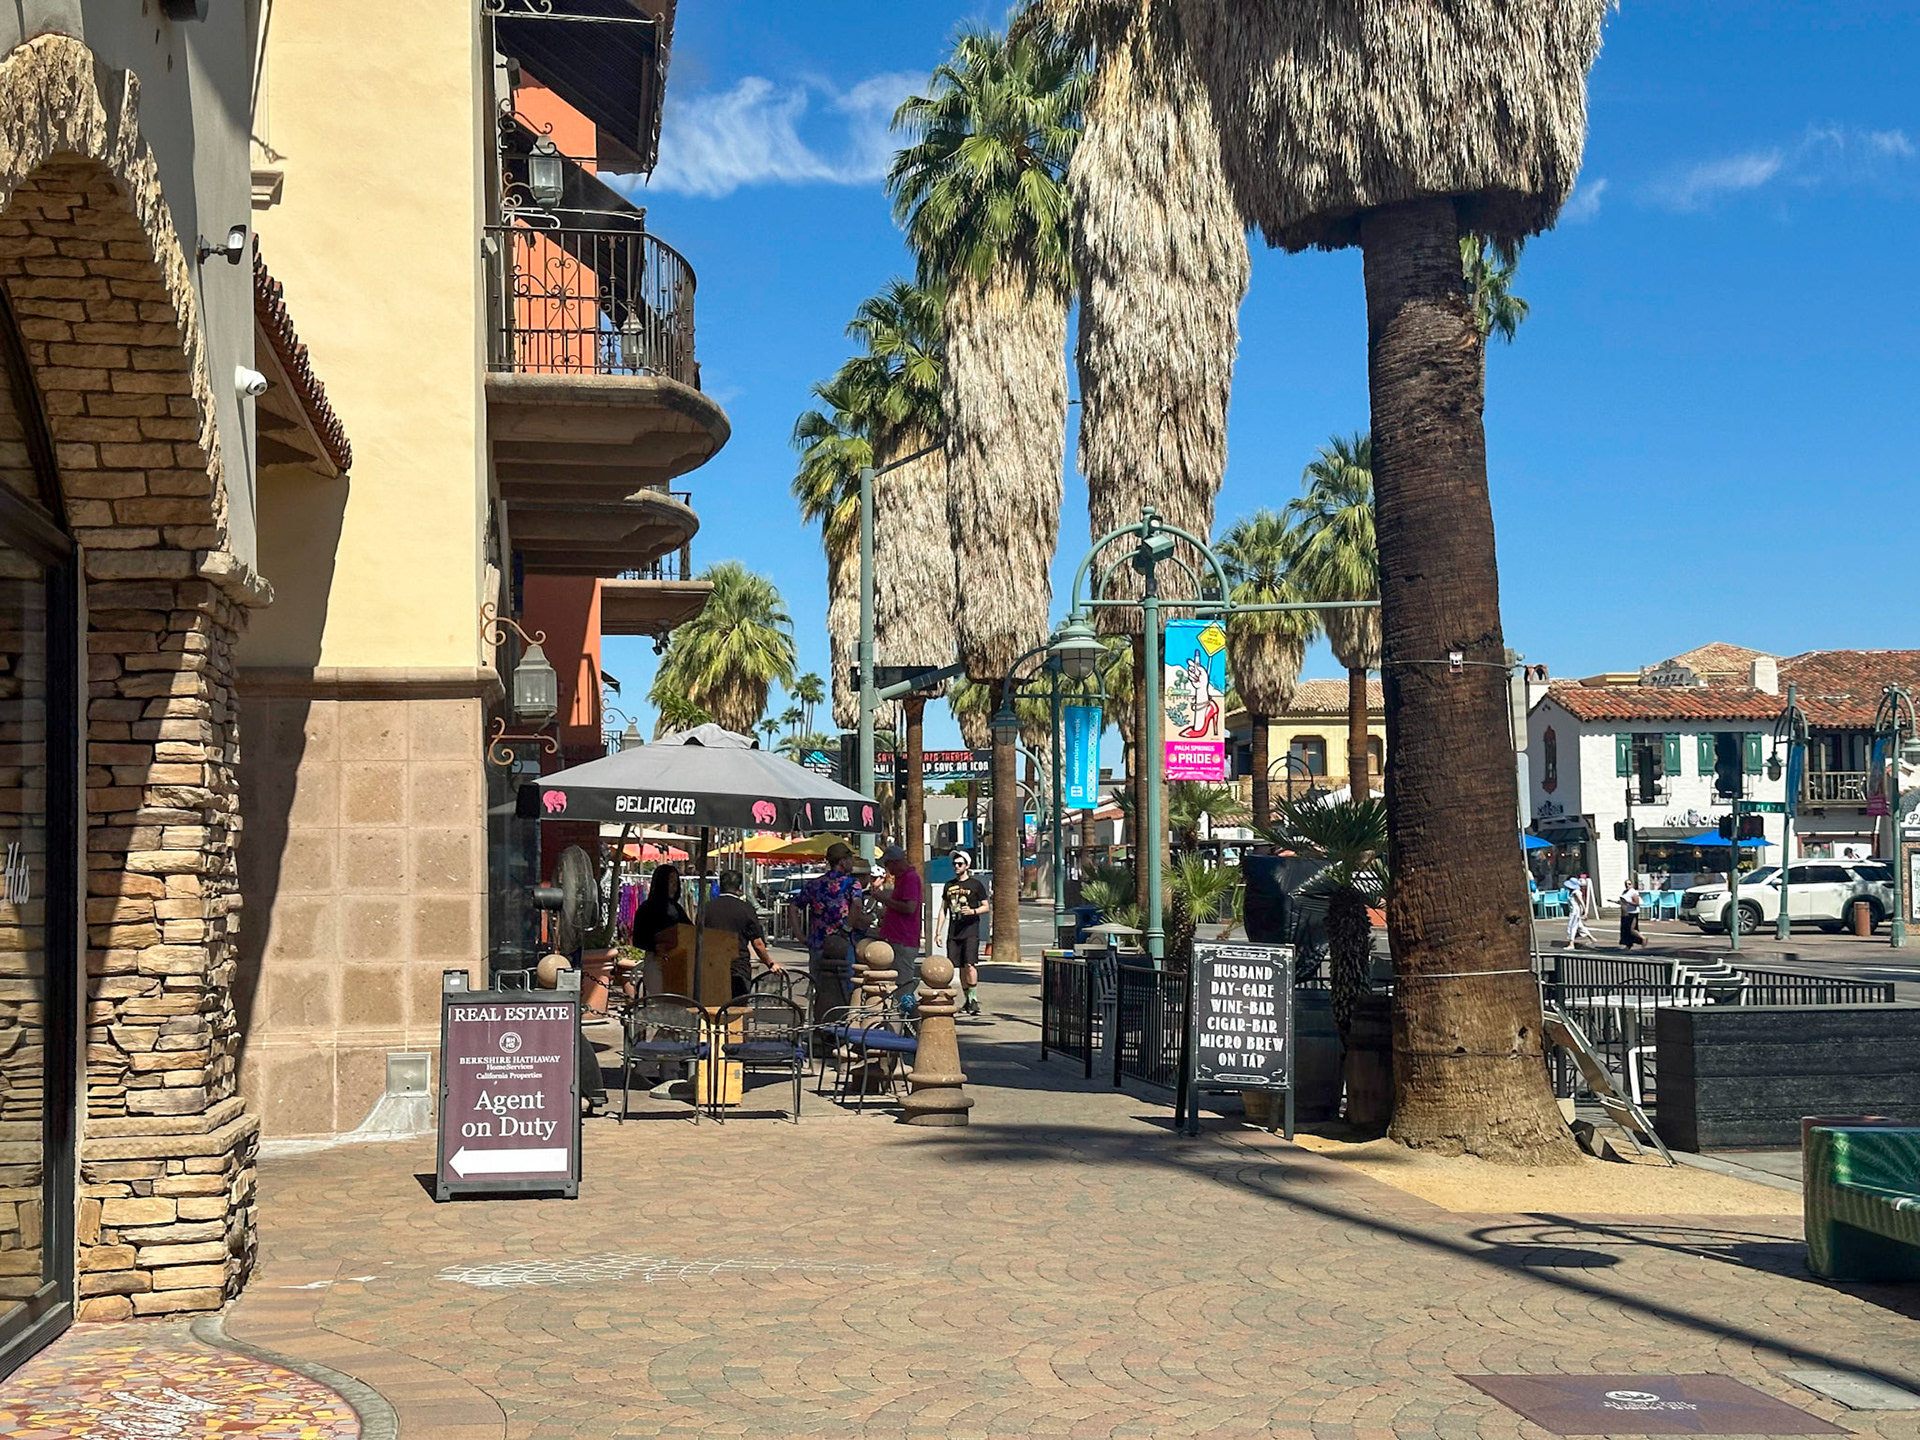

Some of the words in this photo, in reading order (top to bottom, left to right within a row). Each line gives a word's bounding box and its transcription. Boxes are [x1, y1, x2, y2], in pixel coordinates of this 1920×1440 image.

[934, 762, 954, 773] SAVE
[956, 762, 968, 772] AN
[970, 761, 989, 772] ICON
[1178, 753, 1212, 764] PRIDE
[615, 795, 696, 815] DELIRIUM
[1741, 804, 1752, 812] LA
[1755, 804, 1781, 812] PLAZA
[1213, 963, 1273, 981] HUSBAND
[1210, 981, 1275, 998] DAY-CARE
[454, 1007, 501, 1022] REAL
[504, 1006, 570, 1021] ESTATE
[1210, 999, 1275, 1016] WINE-BAR
[1207, 1016, 1278, 1033] CIGAR-BAR
[1200, 1033, 1242, 1049] MICRO
[1246, 1036, 1284, 1052] BREW
[459, 1056, 511, 1065] BERKSHIRE
[512, 1055, 560, 1064] HATHAWAY
[1218, 1052, 1236, 1067] ON
[1241, 1053, 1266, 1069] TAP
[509, 1071, 543, 1080] Properties
[473, 1090, 545, 1115] Agent
[461, 1122, 492, 1138] on
[498, 1116, 558, 1141] Duty
